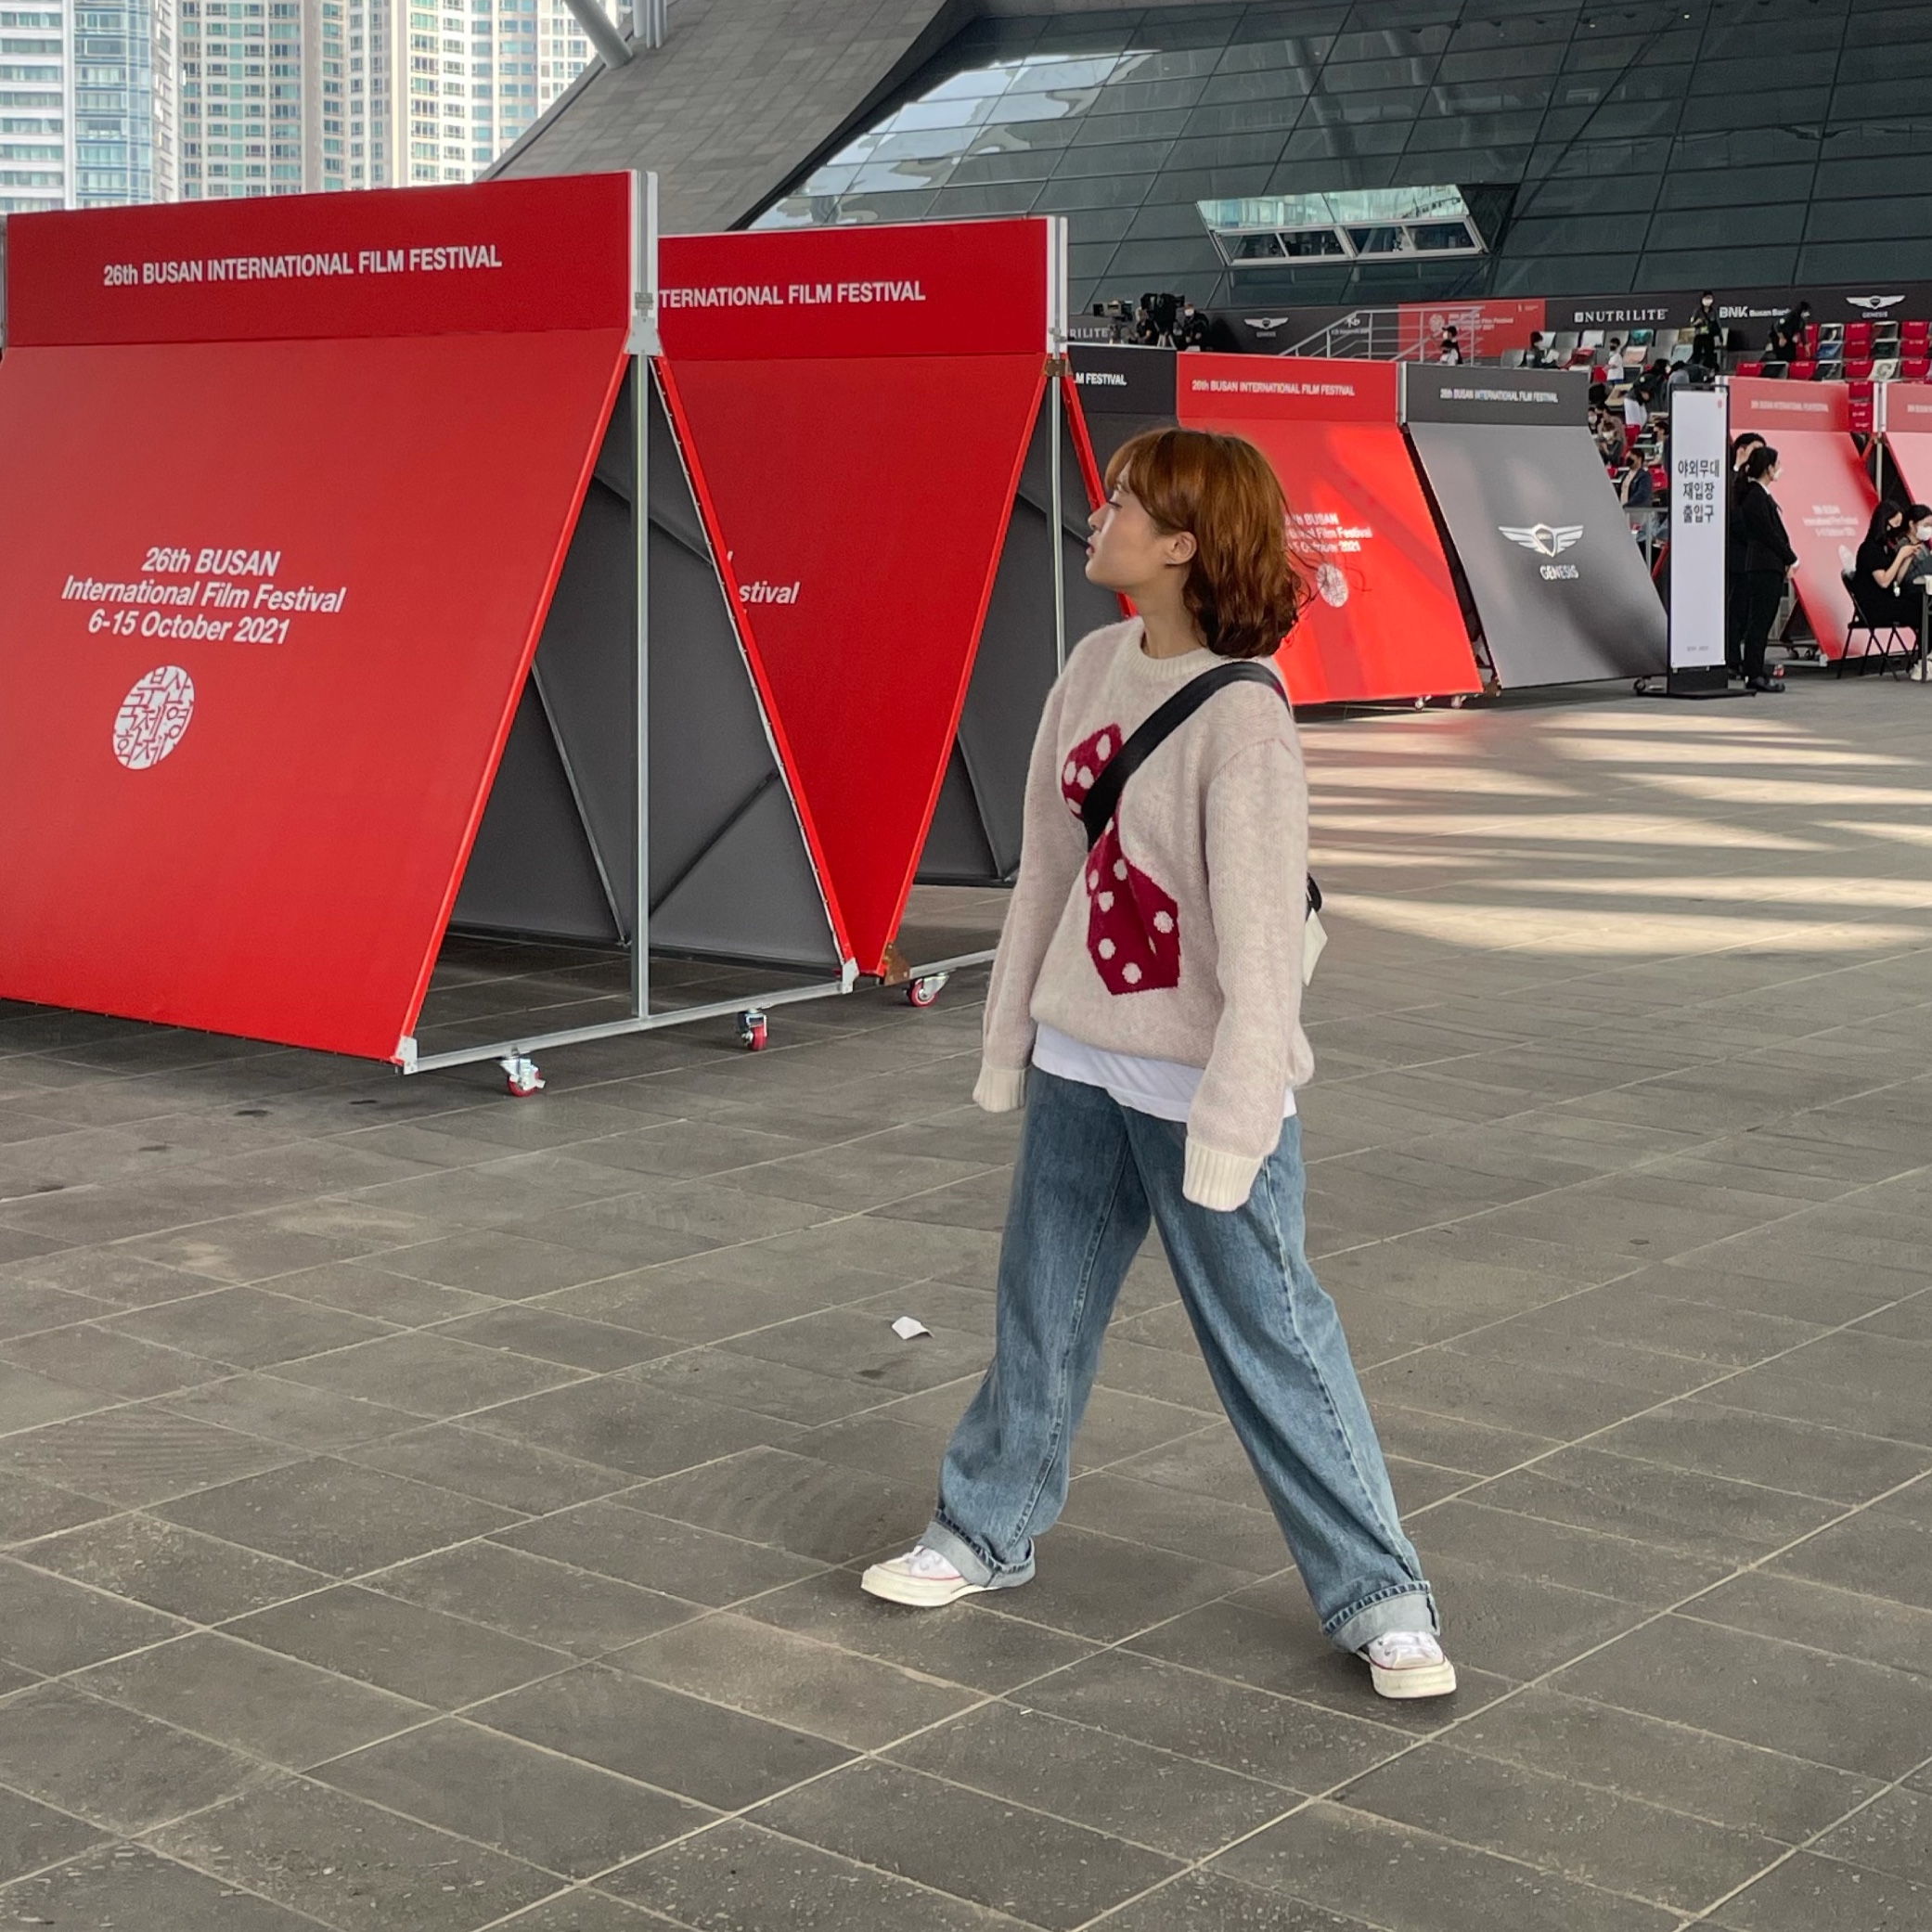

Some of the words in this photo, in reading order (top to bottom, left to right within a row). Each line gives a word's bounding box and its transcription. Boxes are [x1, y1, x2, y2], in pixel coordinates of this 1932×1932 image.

[104, 264, 138, 286] 26th
[143, 260, 202, 284] BUSAN
[208, 252, 354, 281] INTERNATIONAL
[359, 250, 404, 274] FILM
[409, 244, 502, 271] FESTIVAL
[659, 286, 783, 308] TERNATIONAL
[789, 284, 831, 304] FILM
[837, 281, 926, 303] FESTIVAL
[1585, 308, 1668, 323] NUTRILITE
[1719, 306, 1748, 318] BNK
[1086, 373, 1127, 386] FESTIVAL
[1210, 380, 1238, 393] BUSAN
[1240, 381, 1300, 394] INTERNATIONAL
[1301, 383, 1320, 396] FILM
[1320, 384, 1356, 397] FESTIVAL
[1678, 459, 1719, 478] 야외무대
[1683, 482, 1715, 500] 재입장
[1683, 505, 1714, 523] 출입구
[141, 547, 191, 573] 26th
[194, 548, 281, 576] BUSAN
[1539, 564, 1578, 580] GENESIS
[61, 574, 200, 606] International
[200, 581, 251, 609] Film
[253, 584, 347, 613] Festival
[739, 581, 800, 604] stival
[87, 608, 139, 635] 6-15
[141, 611, 233, 641] October
[233, 616, 290, 644] 2021
